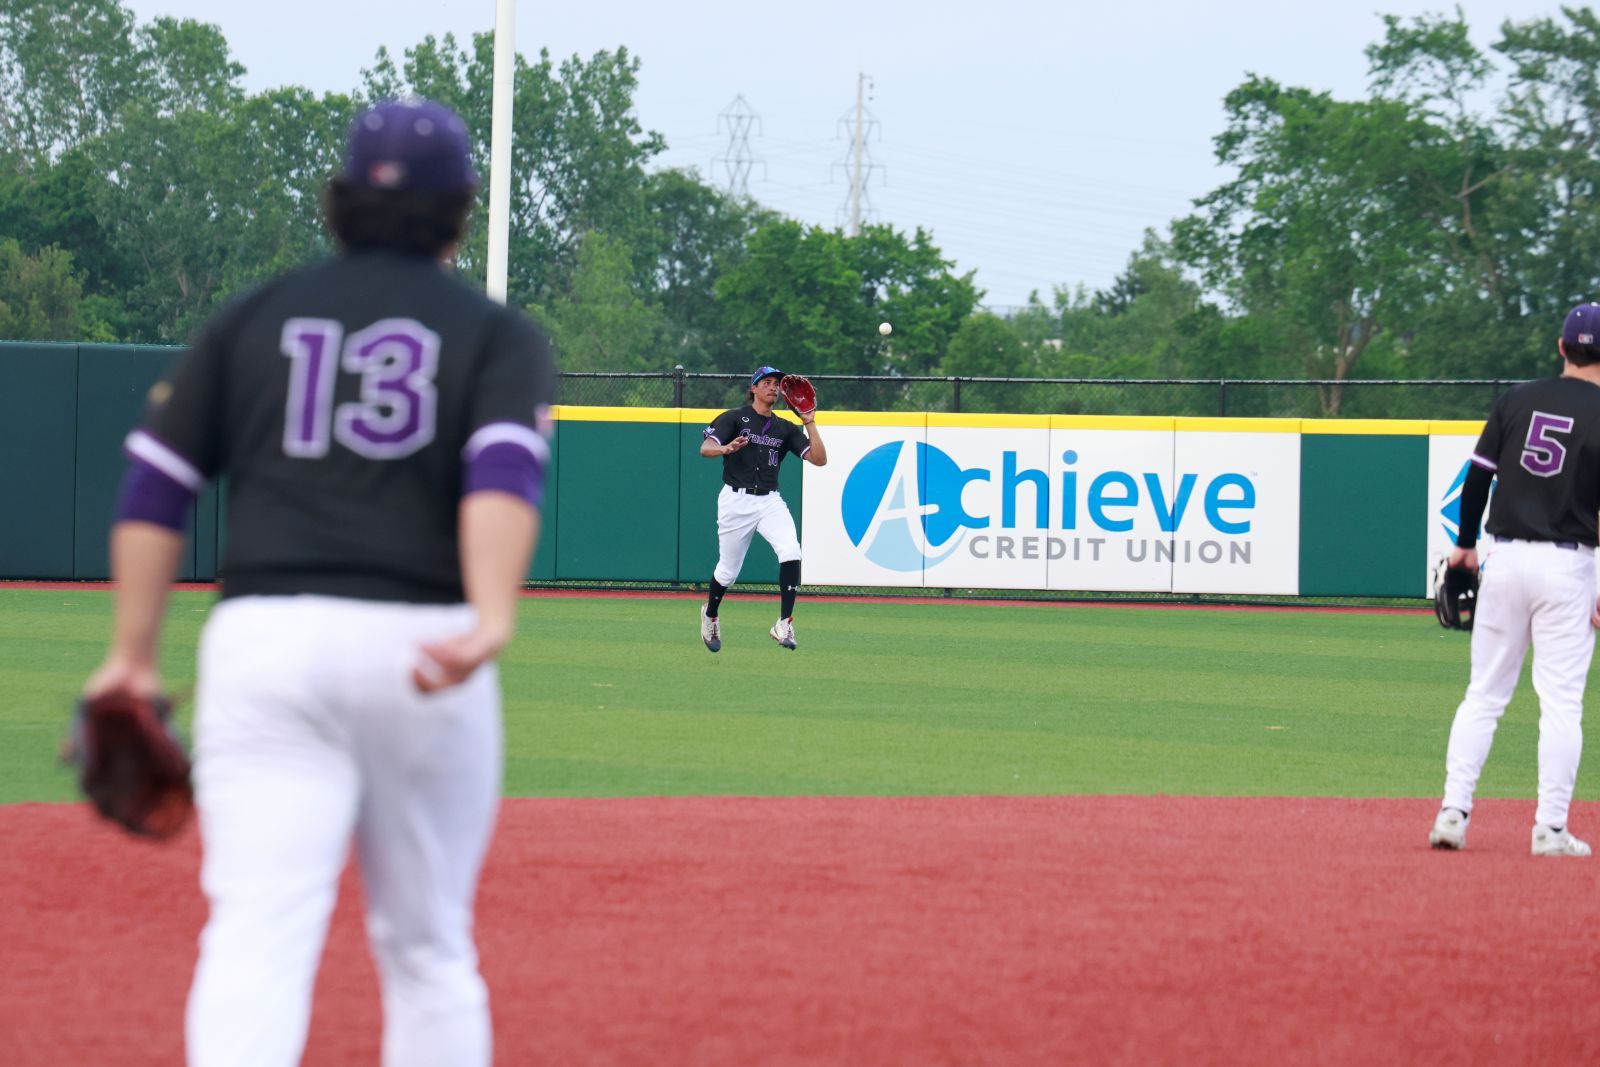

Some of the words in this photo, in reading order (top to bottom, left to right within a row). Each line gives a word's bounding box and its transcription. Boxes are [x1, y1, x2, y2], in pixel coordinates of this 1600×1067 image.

[280, 316, 441, 460] 13
[1520, 410, 1575, 478] 5
[850, 440, 1256, 560] Achieve
[969, 535, 1106, 562] CREDIT
[1126, 539, 1252, 565] UNION
